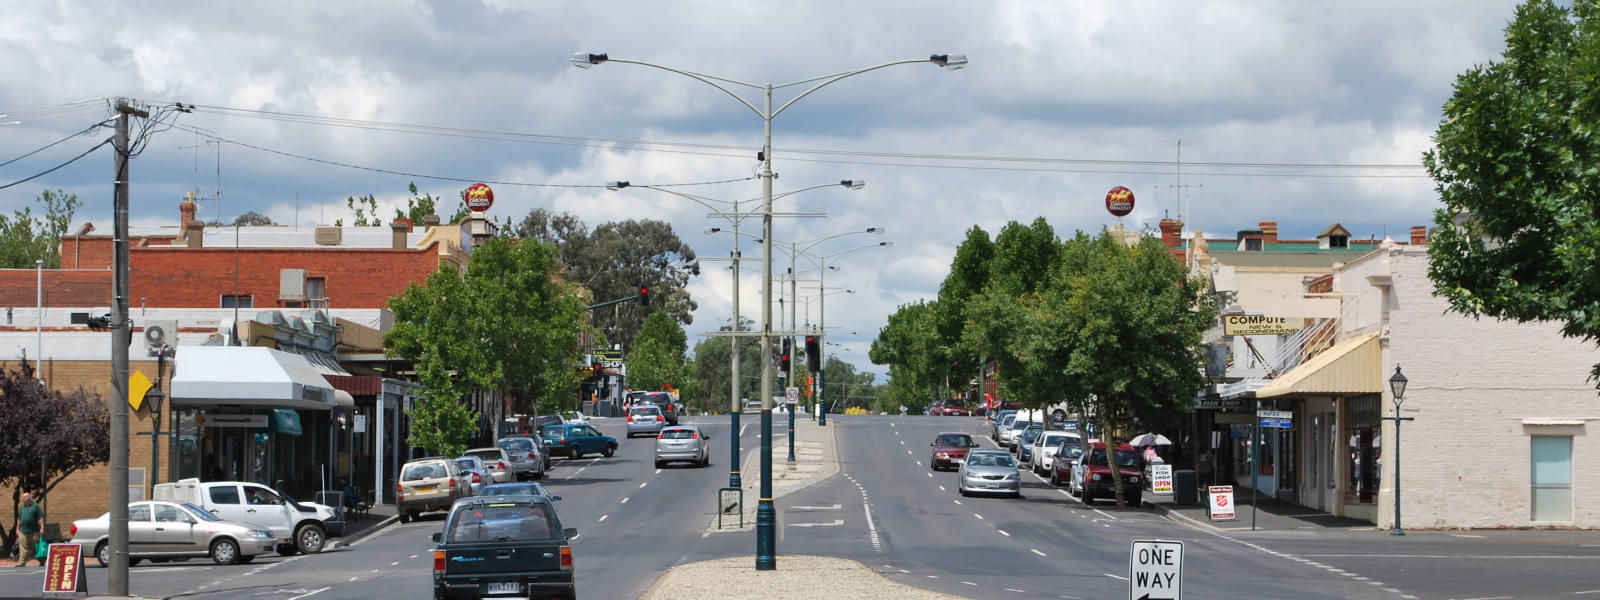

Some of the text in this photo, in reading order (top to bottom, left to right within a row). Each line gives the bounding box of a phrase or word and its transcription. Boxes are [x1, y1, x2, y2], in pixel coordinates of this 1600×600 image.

[603, 360, 622, 368] SHOP
[1139, 548, 1174, 565] ONE
[61, 555, 75, 590] OPEN
[1136, 571, 1175, 589] WAY
